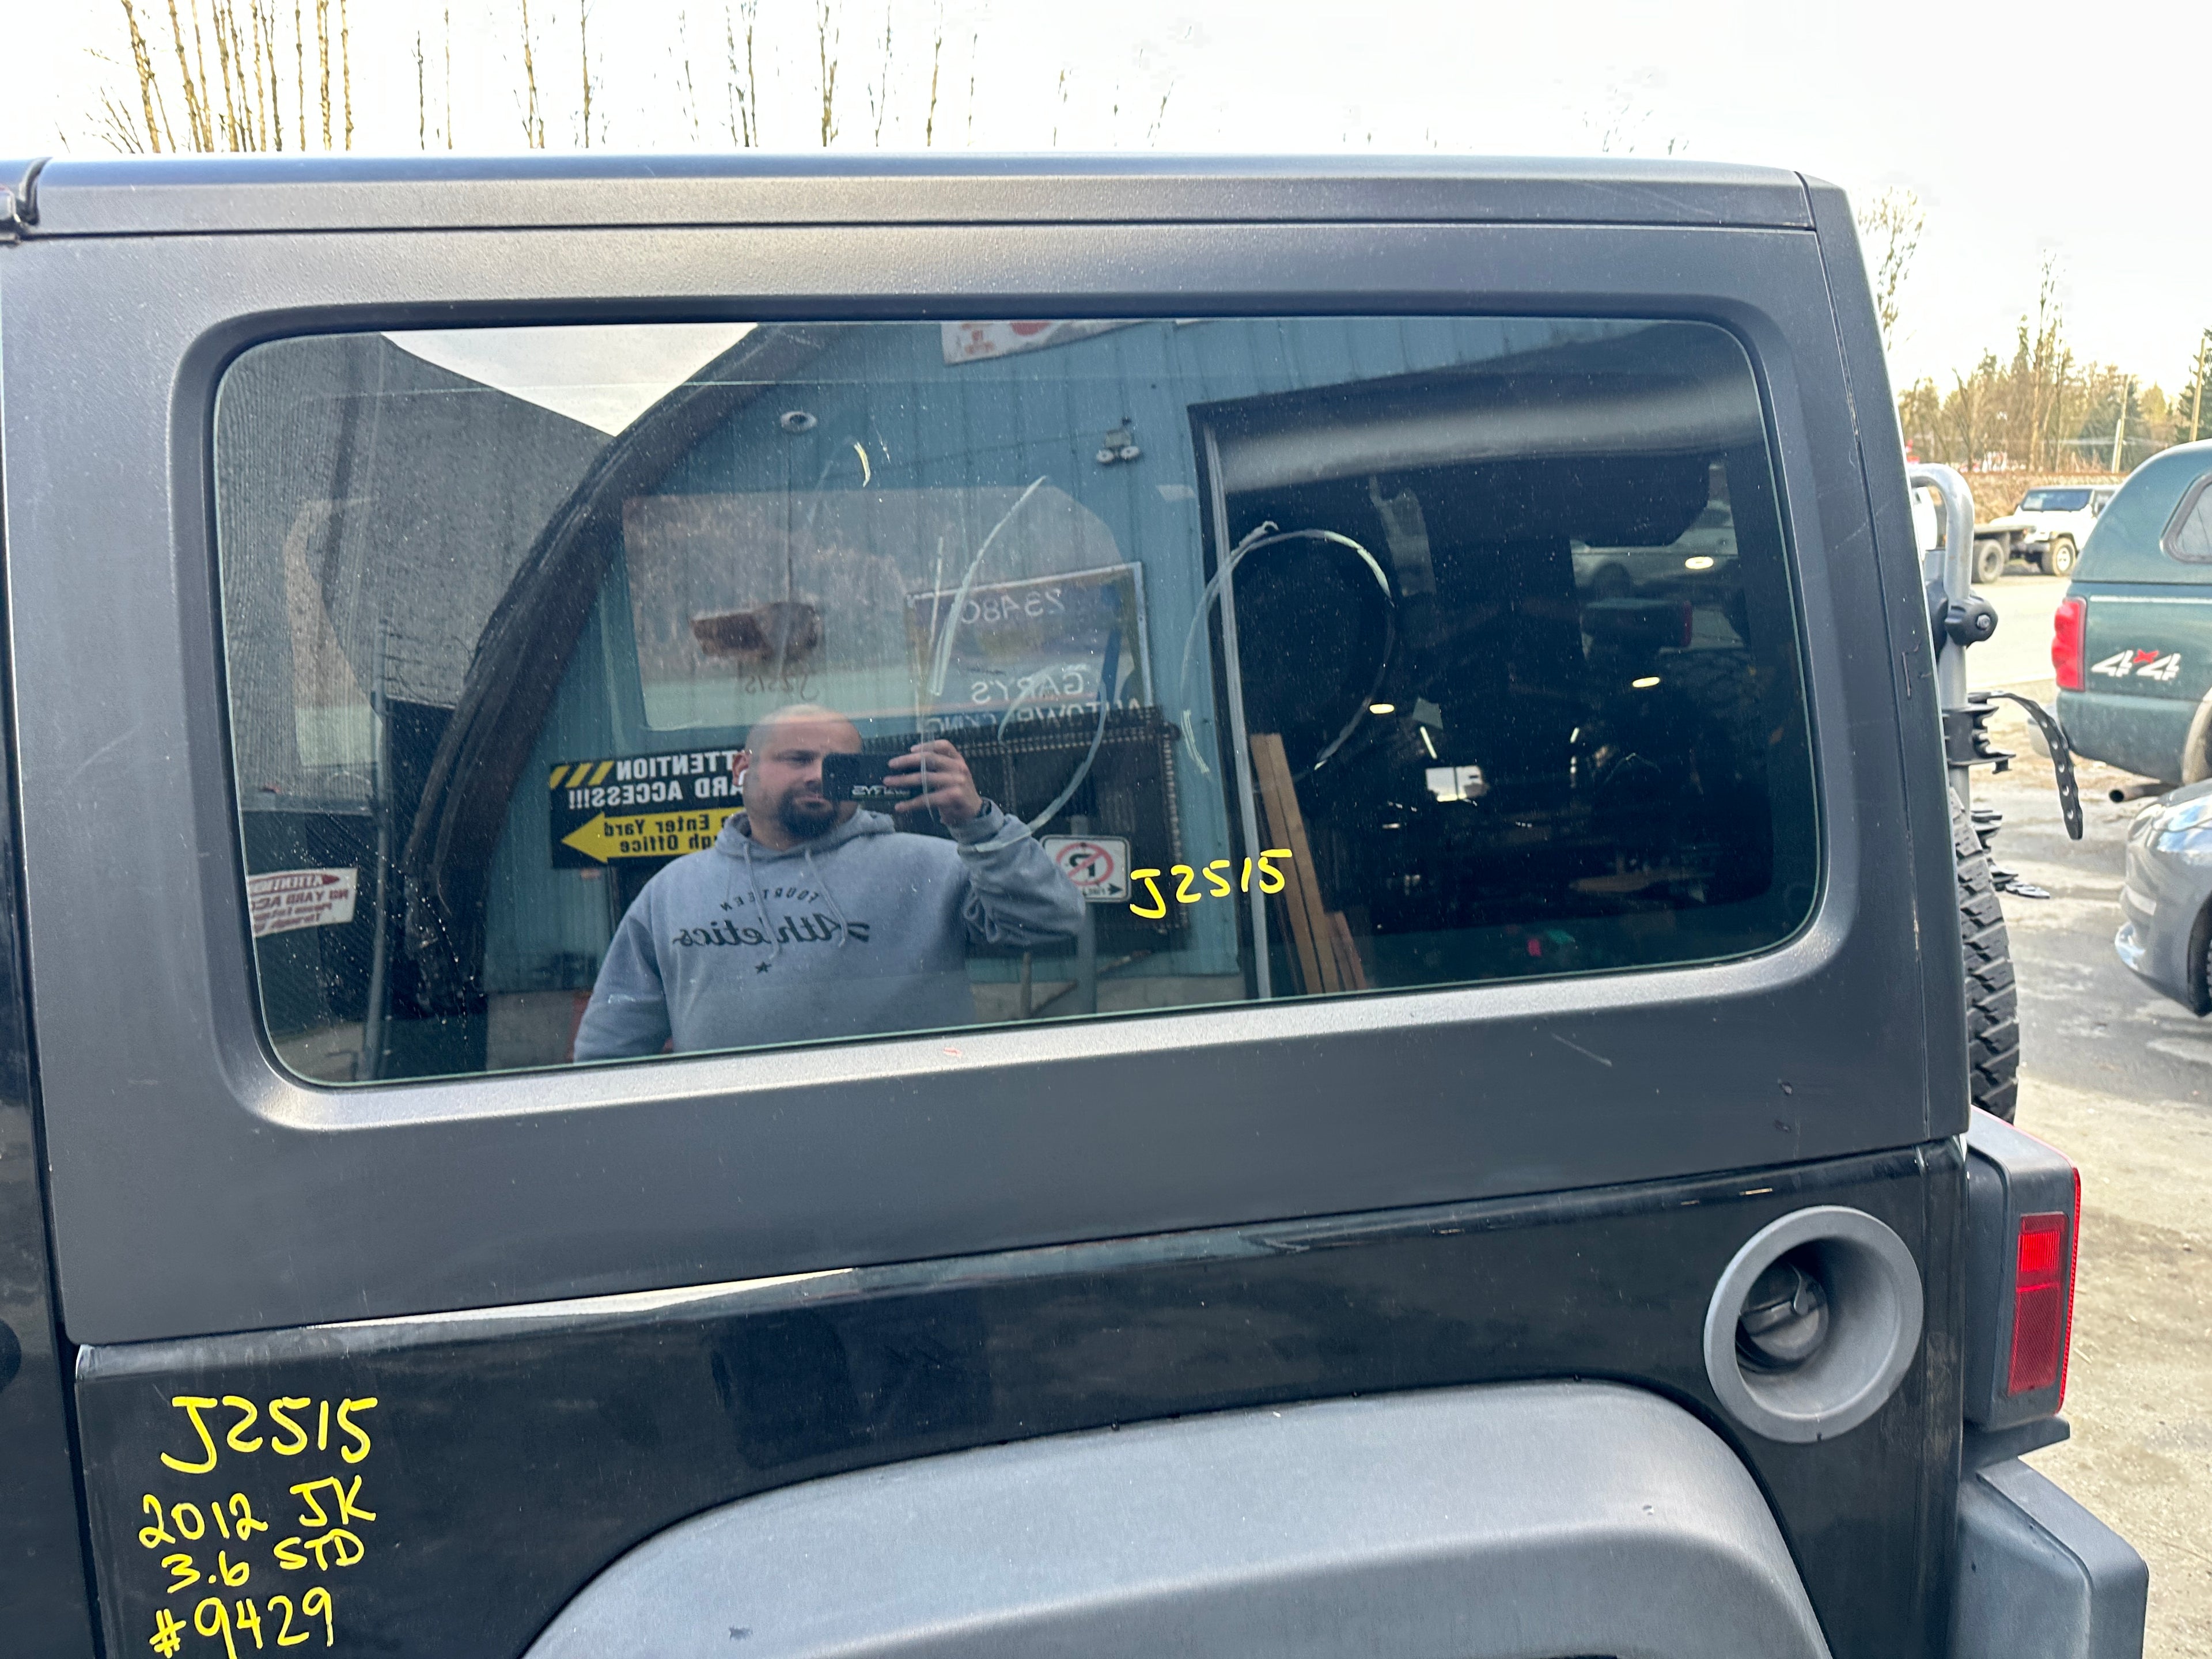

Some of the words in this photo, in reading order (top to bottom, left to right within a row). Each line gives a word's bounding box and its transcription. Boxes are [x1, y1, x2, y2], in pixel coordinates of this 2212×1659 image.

[1130, 849, 1293, 918] J2515
[161, 1395, 378, 1474] J2515
[139, 1492, 268, 1549] 2012
[290, 1475, 377, 1527] JK
[161, 1550, 250, 1593] 3.6
[273, 1528, 365, 1571] STD
[149, 1586, 334, 1659] #9429
